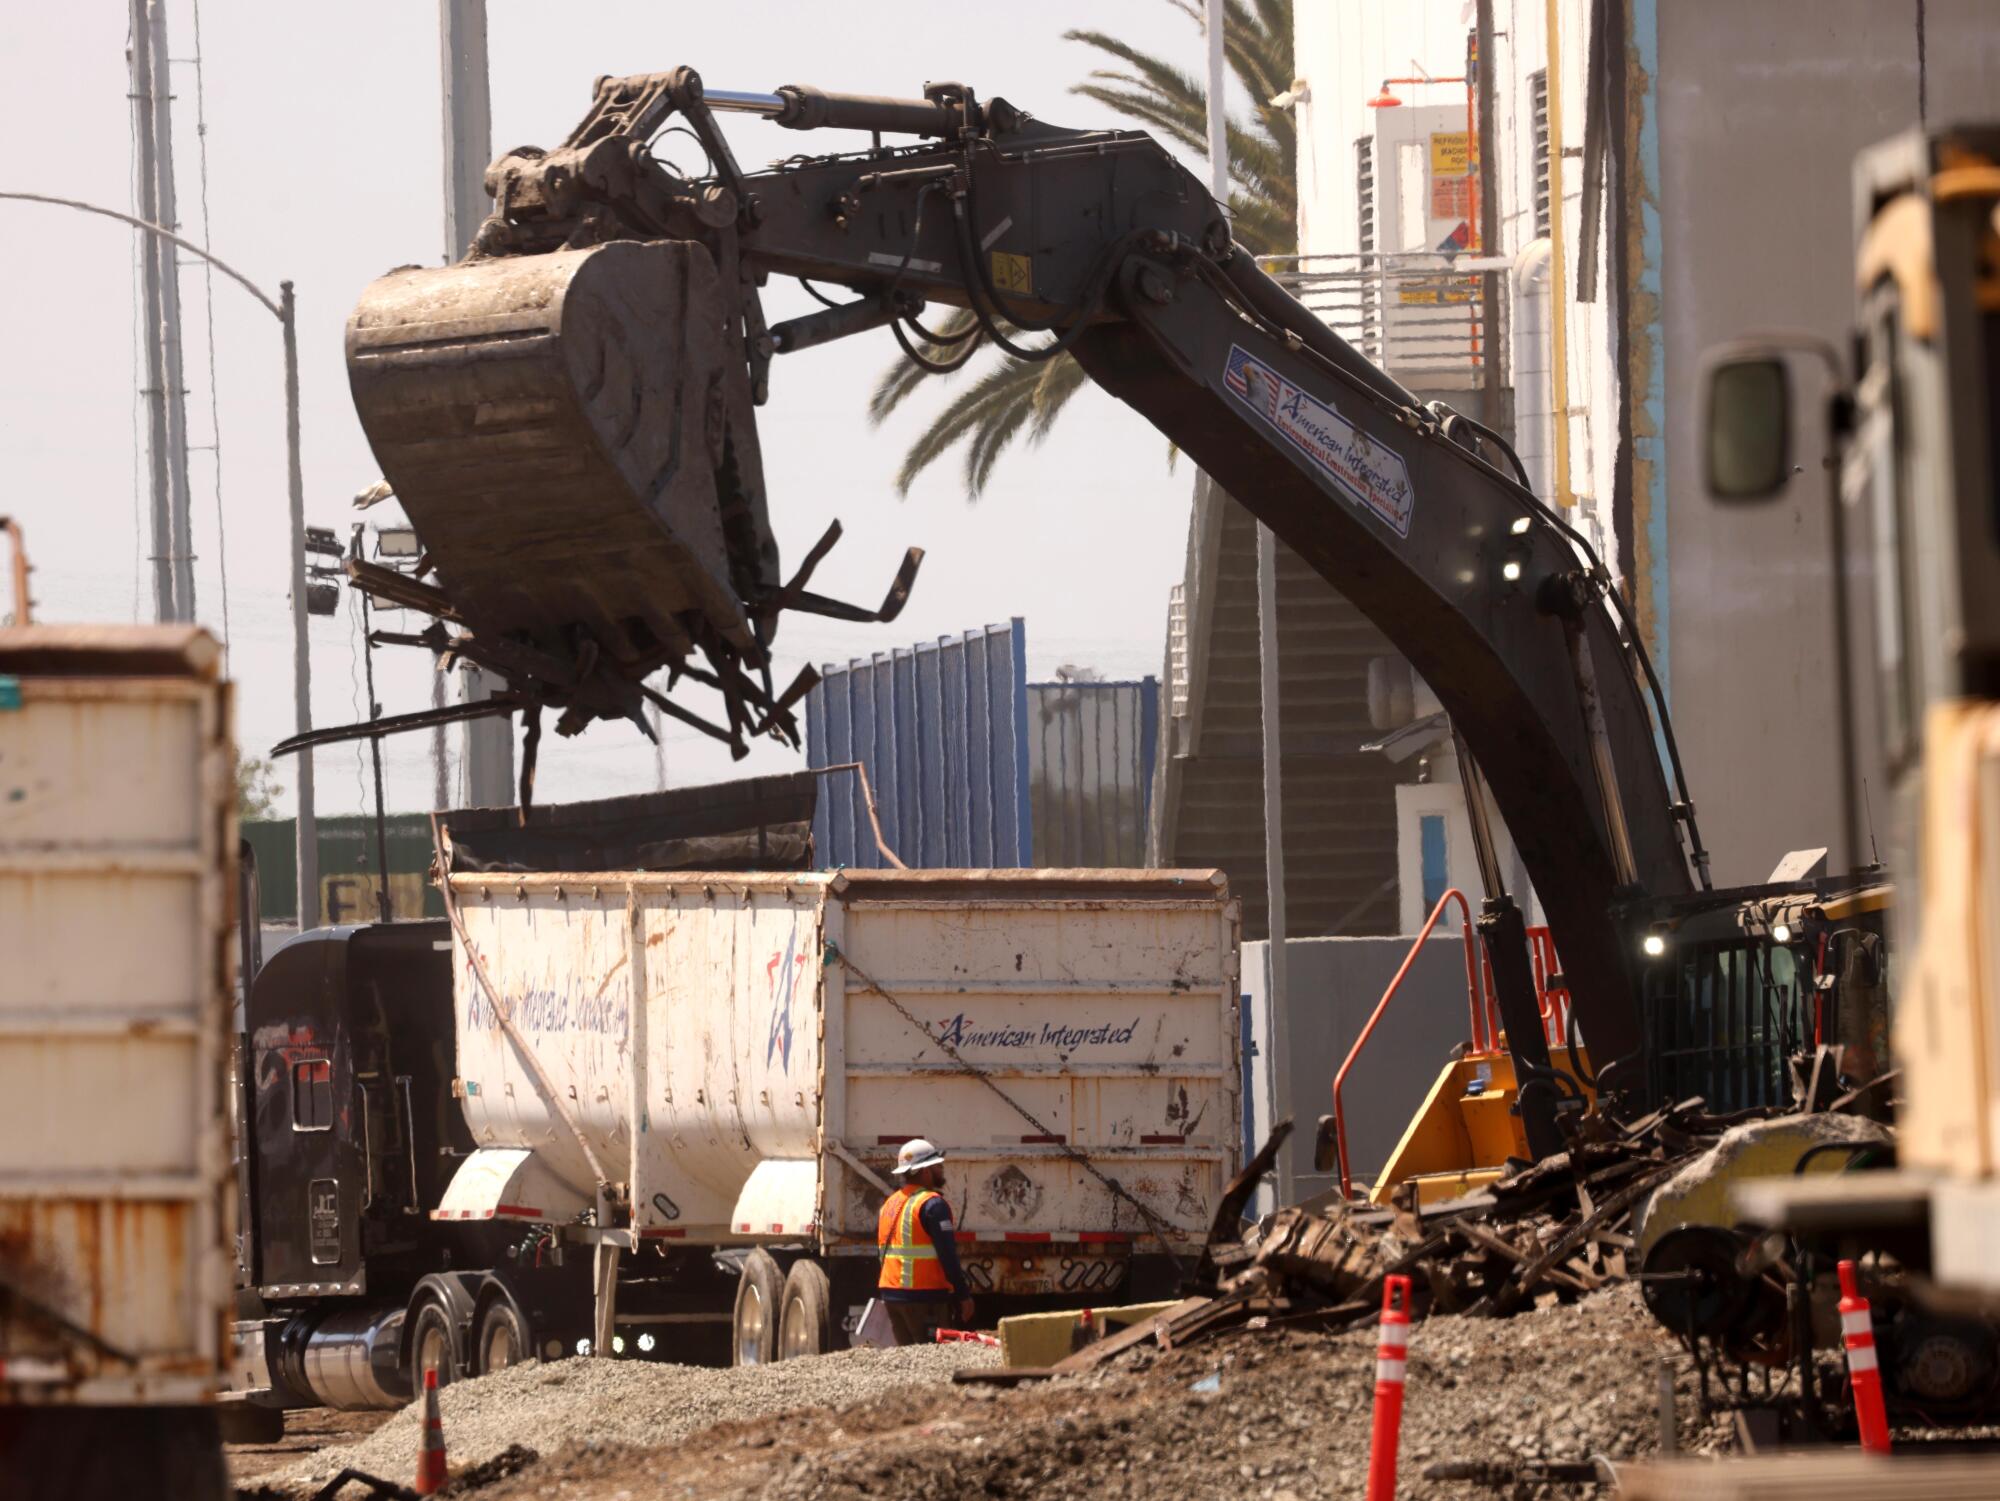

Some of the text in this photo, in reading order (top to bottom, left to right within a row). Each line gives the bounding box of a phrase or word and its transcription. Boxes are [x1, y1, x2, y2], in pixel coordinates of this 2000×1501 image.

[1281, 391, 1408, 504] American Integrated
[938, 1013, 1140, 1050] American Integrated
